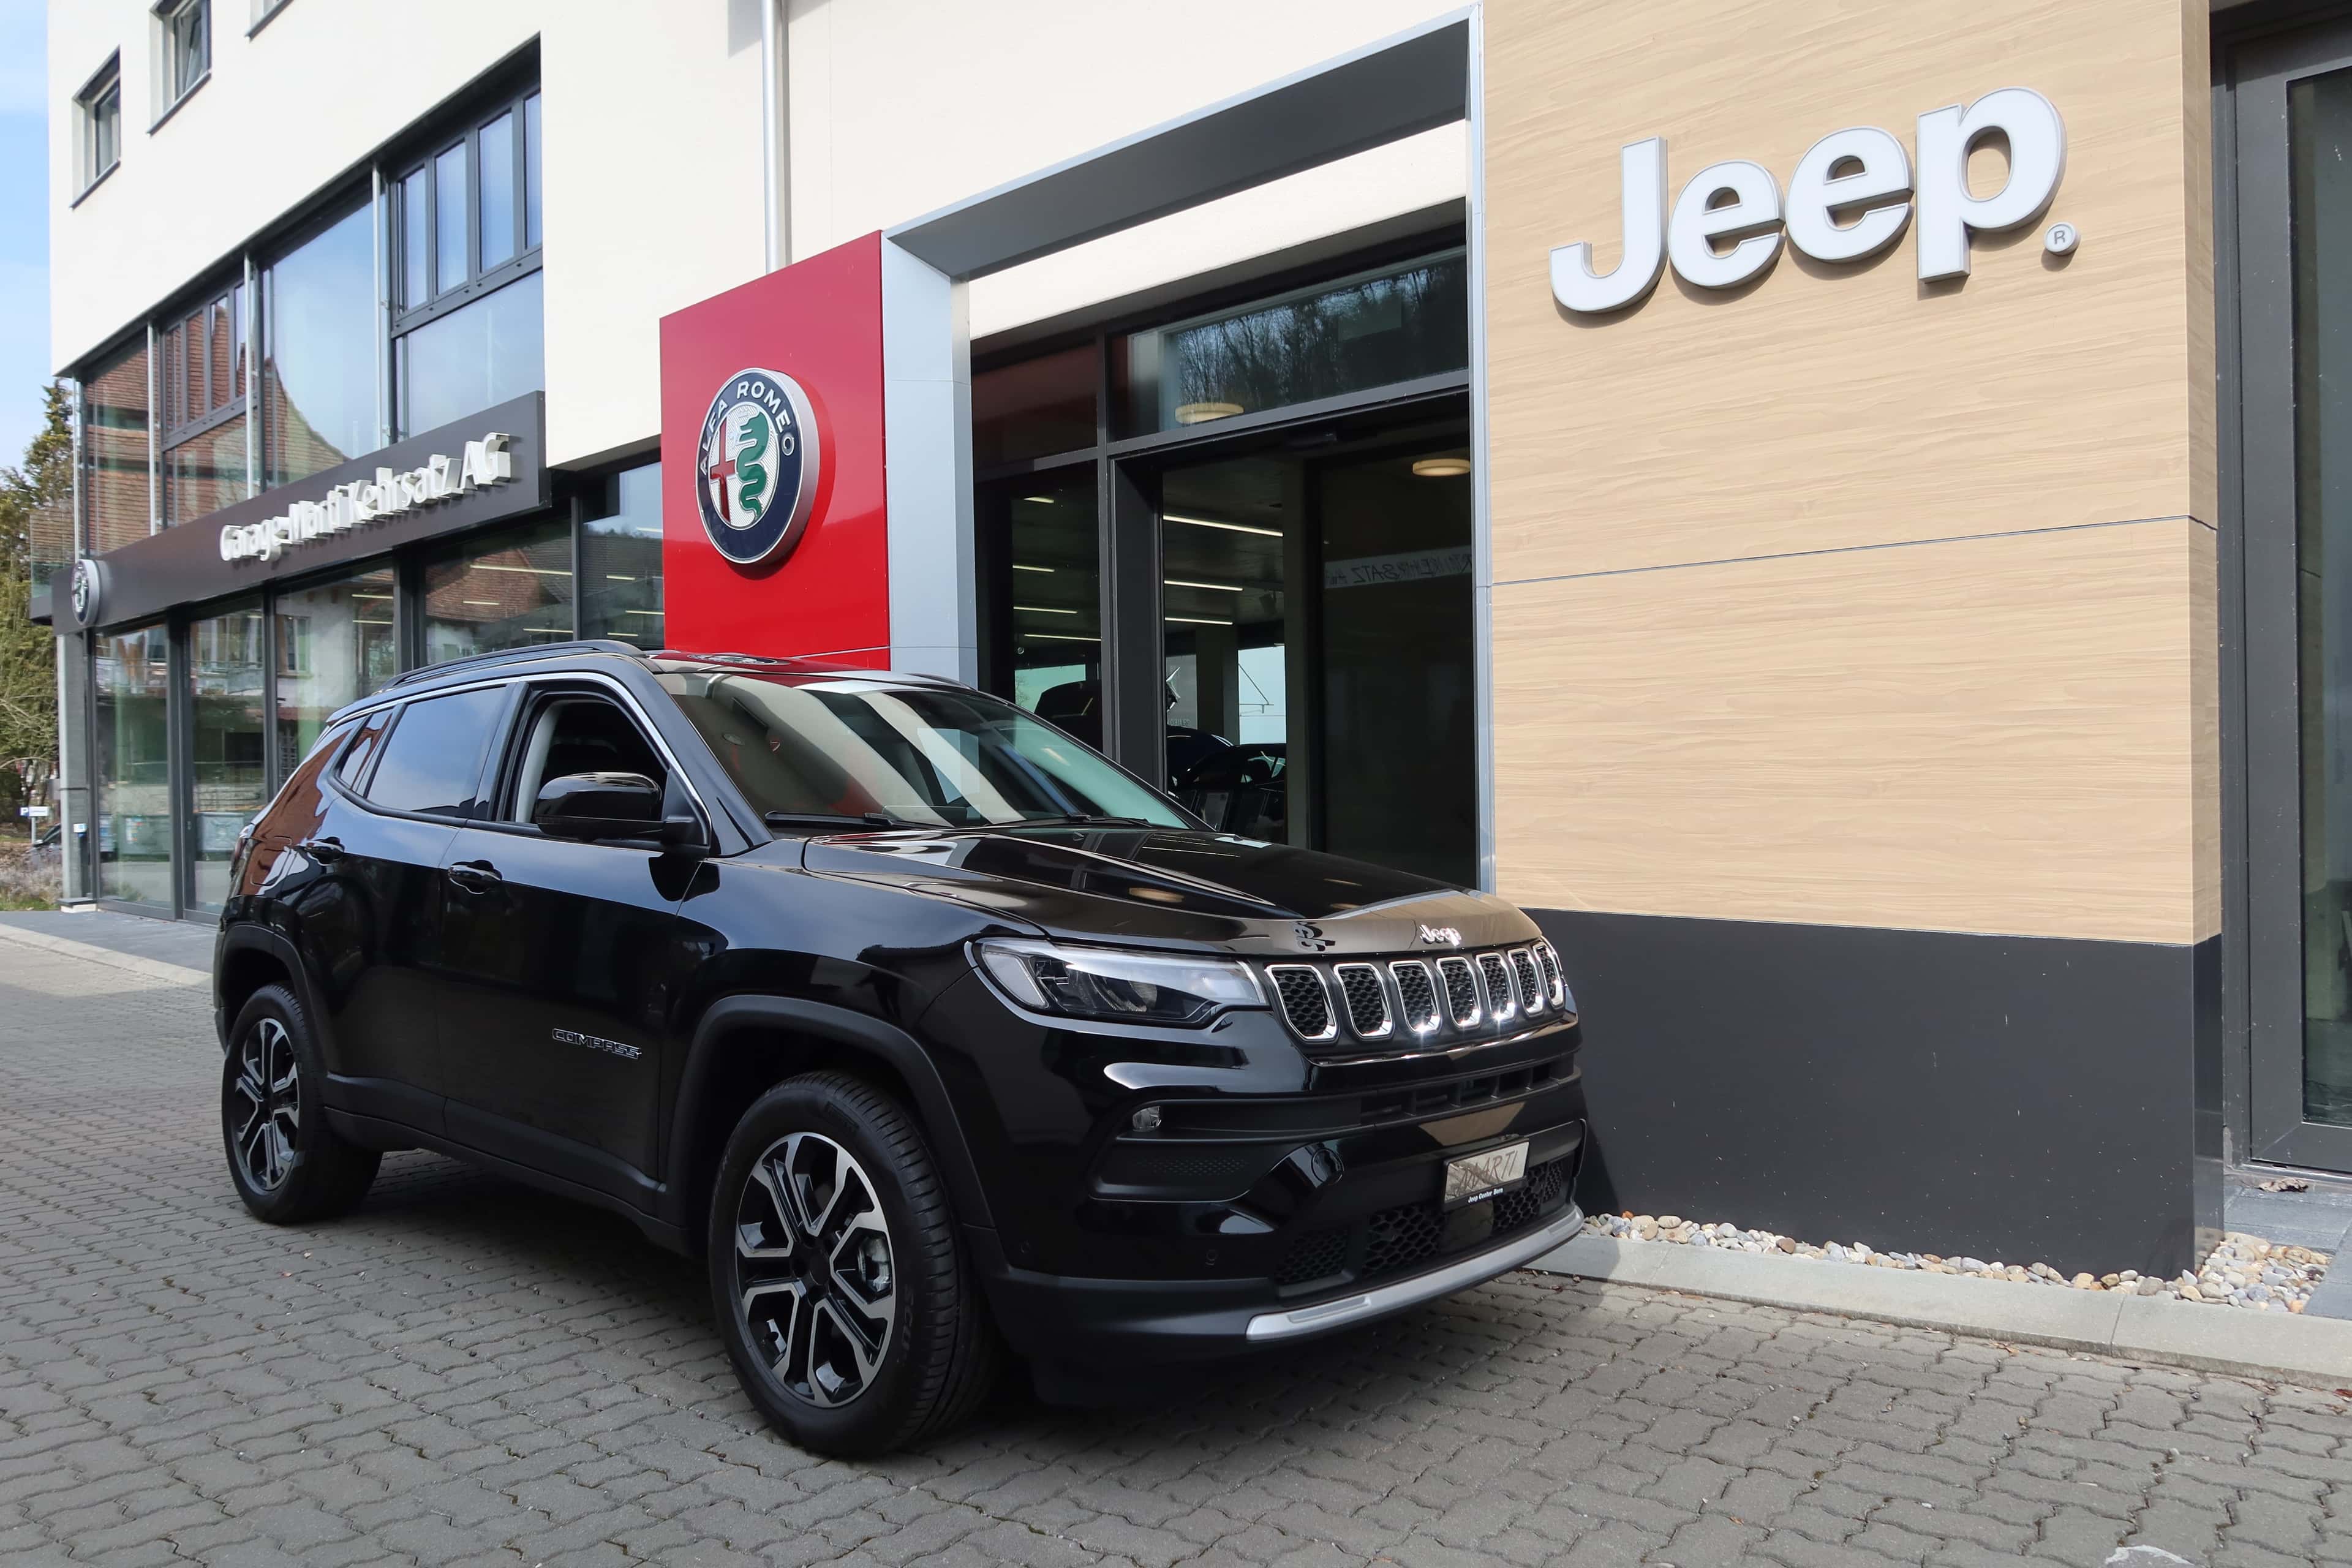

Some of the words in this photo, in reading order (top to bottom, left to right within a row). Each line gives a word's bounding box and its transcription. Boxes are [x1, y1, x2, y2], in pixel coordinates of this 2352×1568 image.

[1548, 86, 2068, 313] Jeep
[699, 399, 728, 476] ALFA
[736, 380, 794, 456] ROMEO
[220, 516, 289, 562] Garage
[461, 432, 511, 492] AG
[1419, 924, 1462, 946] Jeep
[552, 1028, 643, 1059] COMPASS
[1468, 1195, 1479, 1204] Jeep
